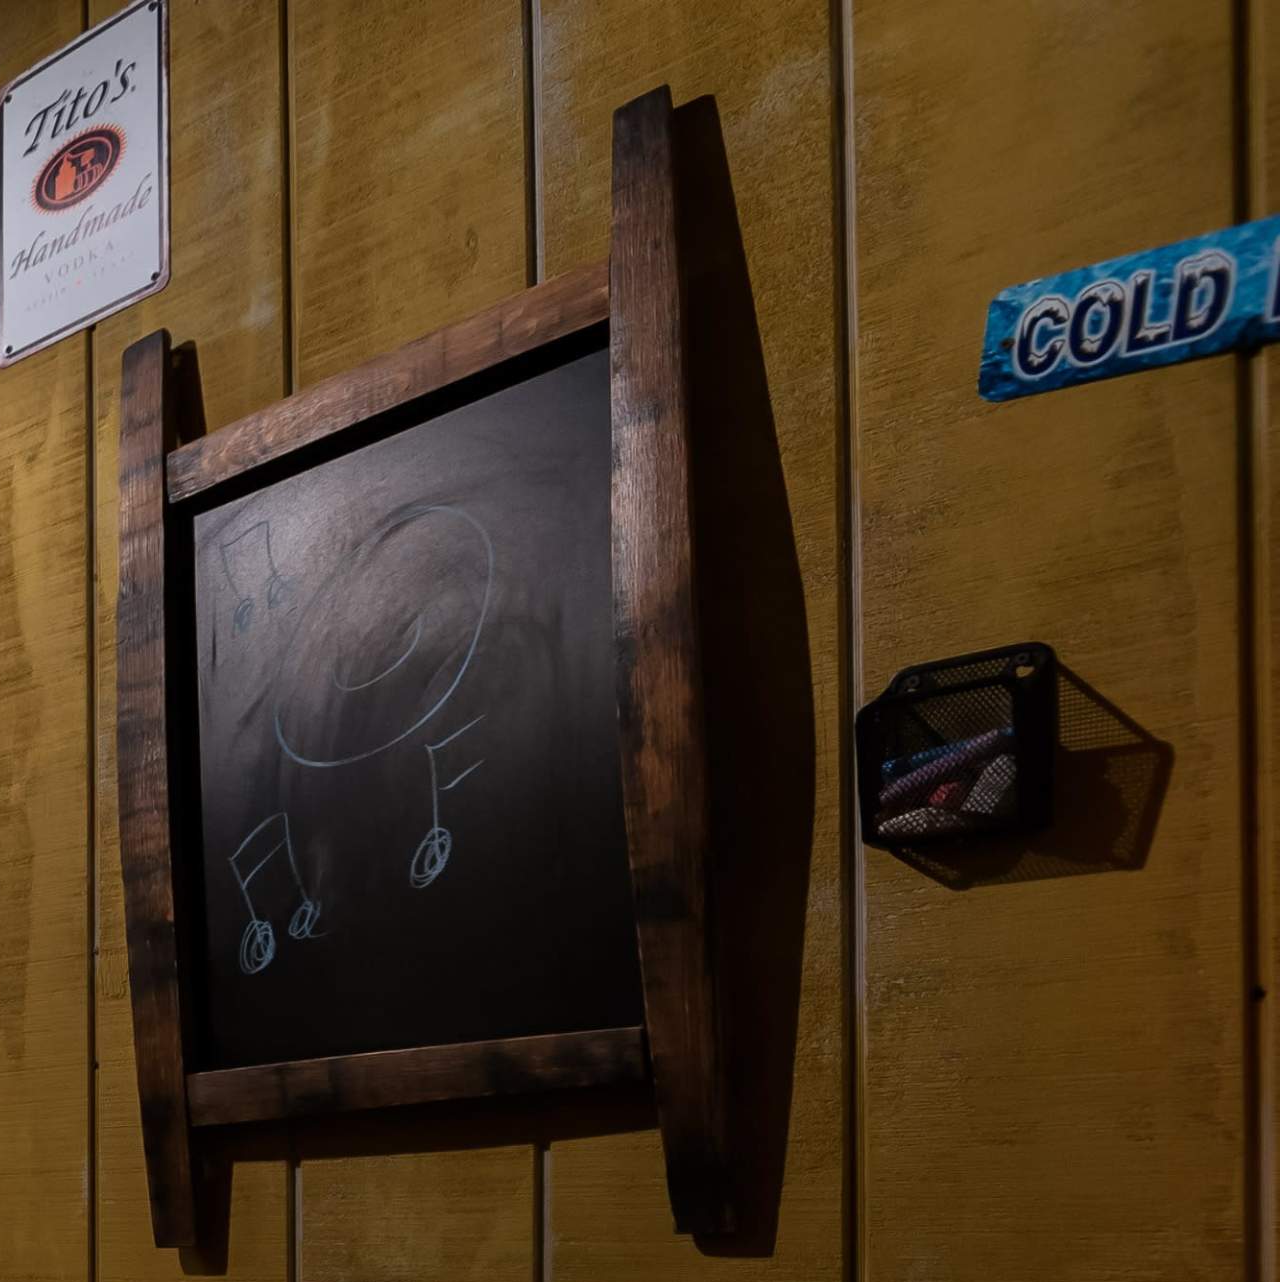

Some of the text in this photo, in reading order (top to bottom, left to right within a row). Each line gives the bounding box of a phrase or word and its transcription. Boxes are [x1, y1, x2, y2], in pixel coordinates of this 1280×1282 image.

[9, 171, 153, 280] Handmade
[43, 240, 116, 284] VODKA
[1013, 248, 1237, 380] COLD
